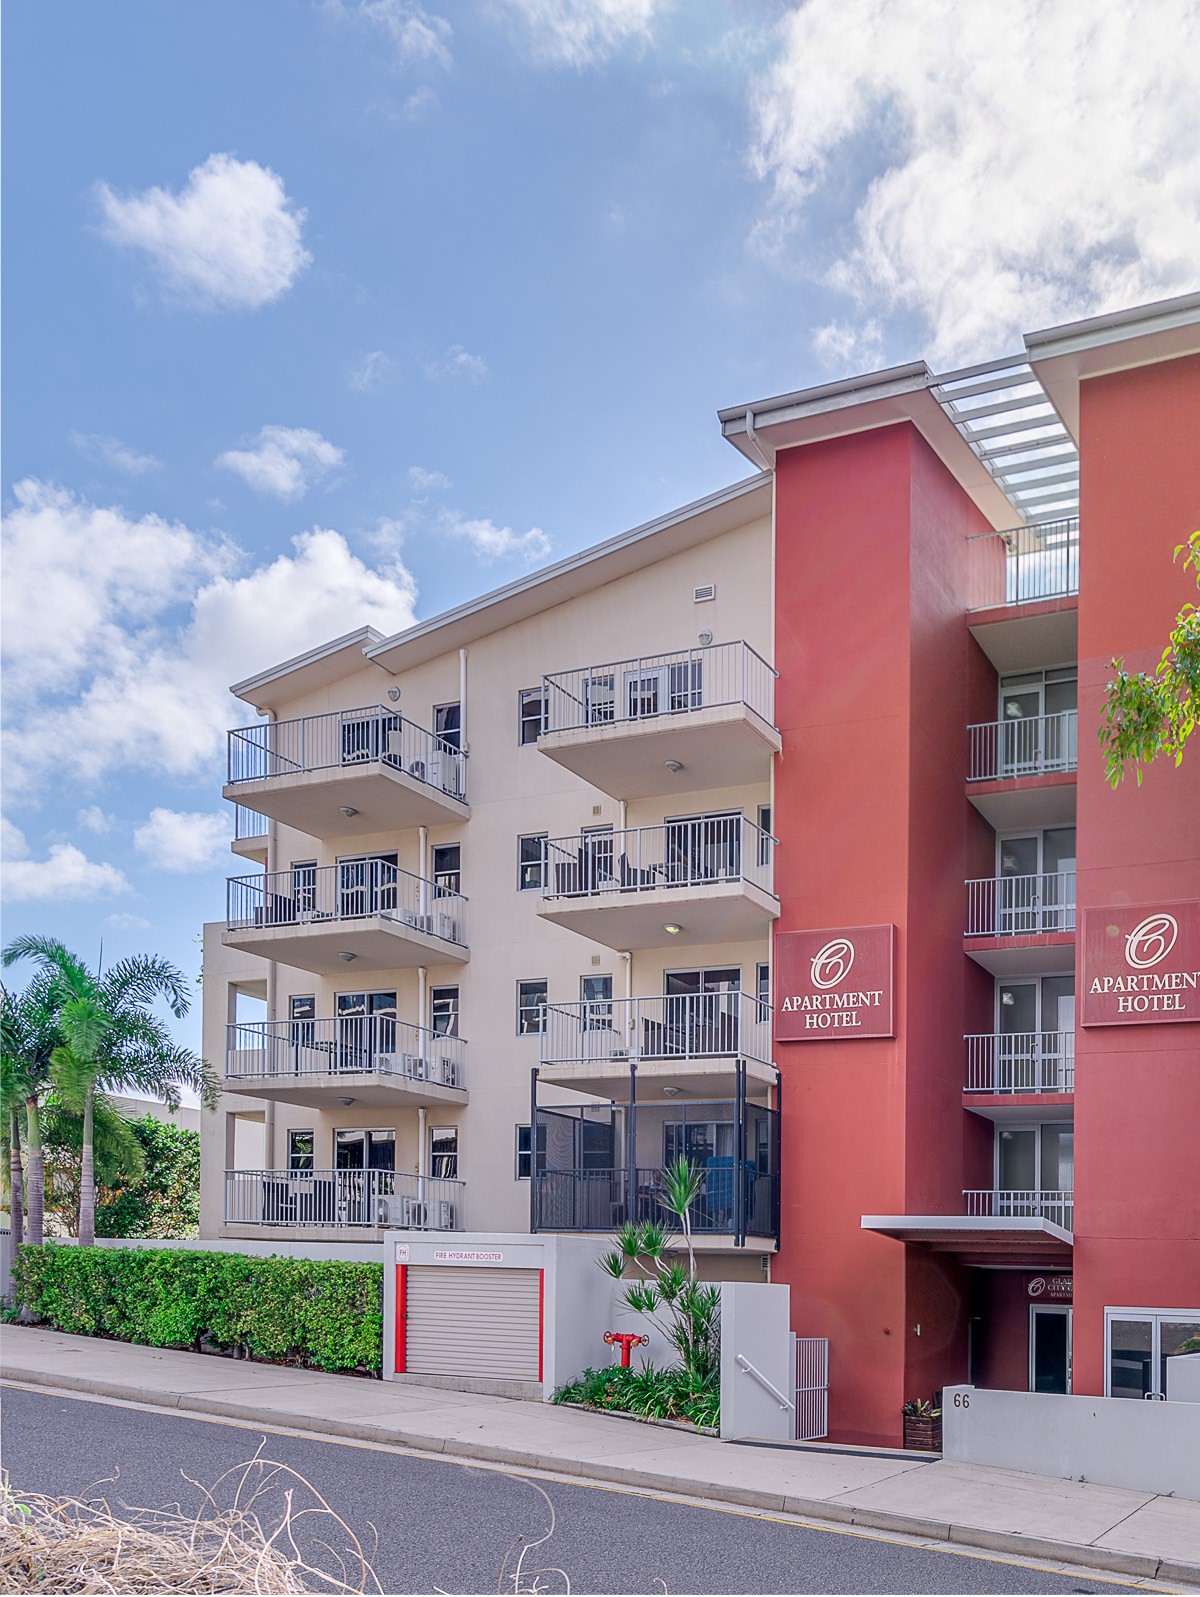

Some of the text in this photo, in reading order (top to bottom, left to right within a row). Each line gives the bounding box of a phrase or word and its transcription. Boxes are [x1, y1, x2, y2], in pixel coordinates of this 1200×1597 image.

[781, 990, 883, 1012] APARTMENT
[1117, 993, 1186, 1013] HOTEL
[804, 1011, 861, 1029] HOTEL
[448, 1252, 475, 1260] HYDRANT
[953, 1393, 970, 1408] 66
